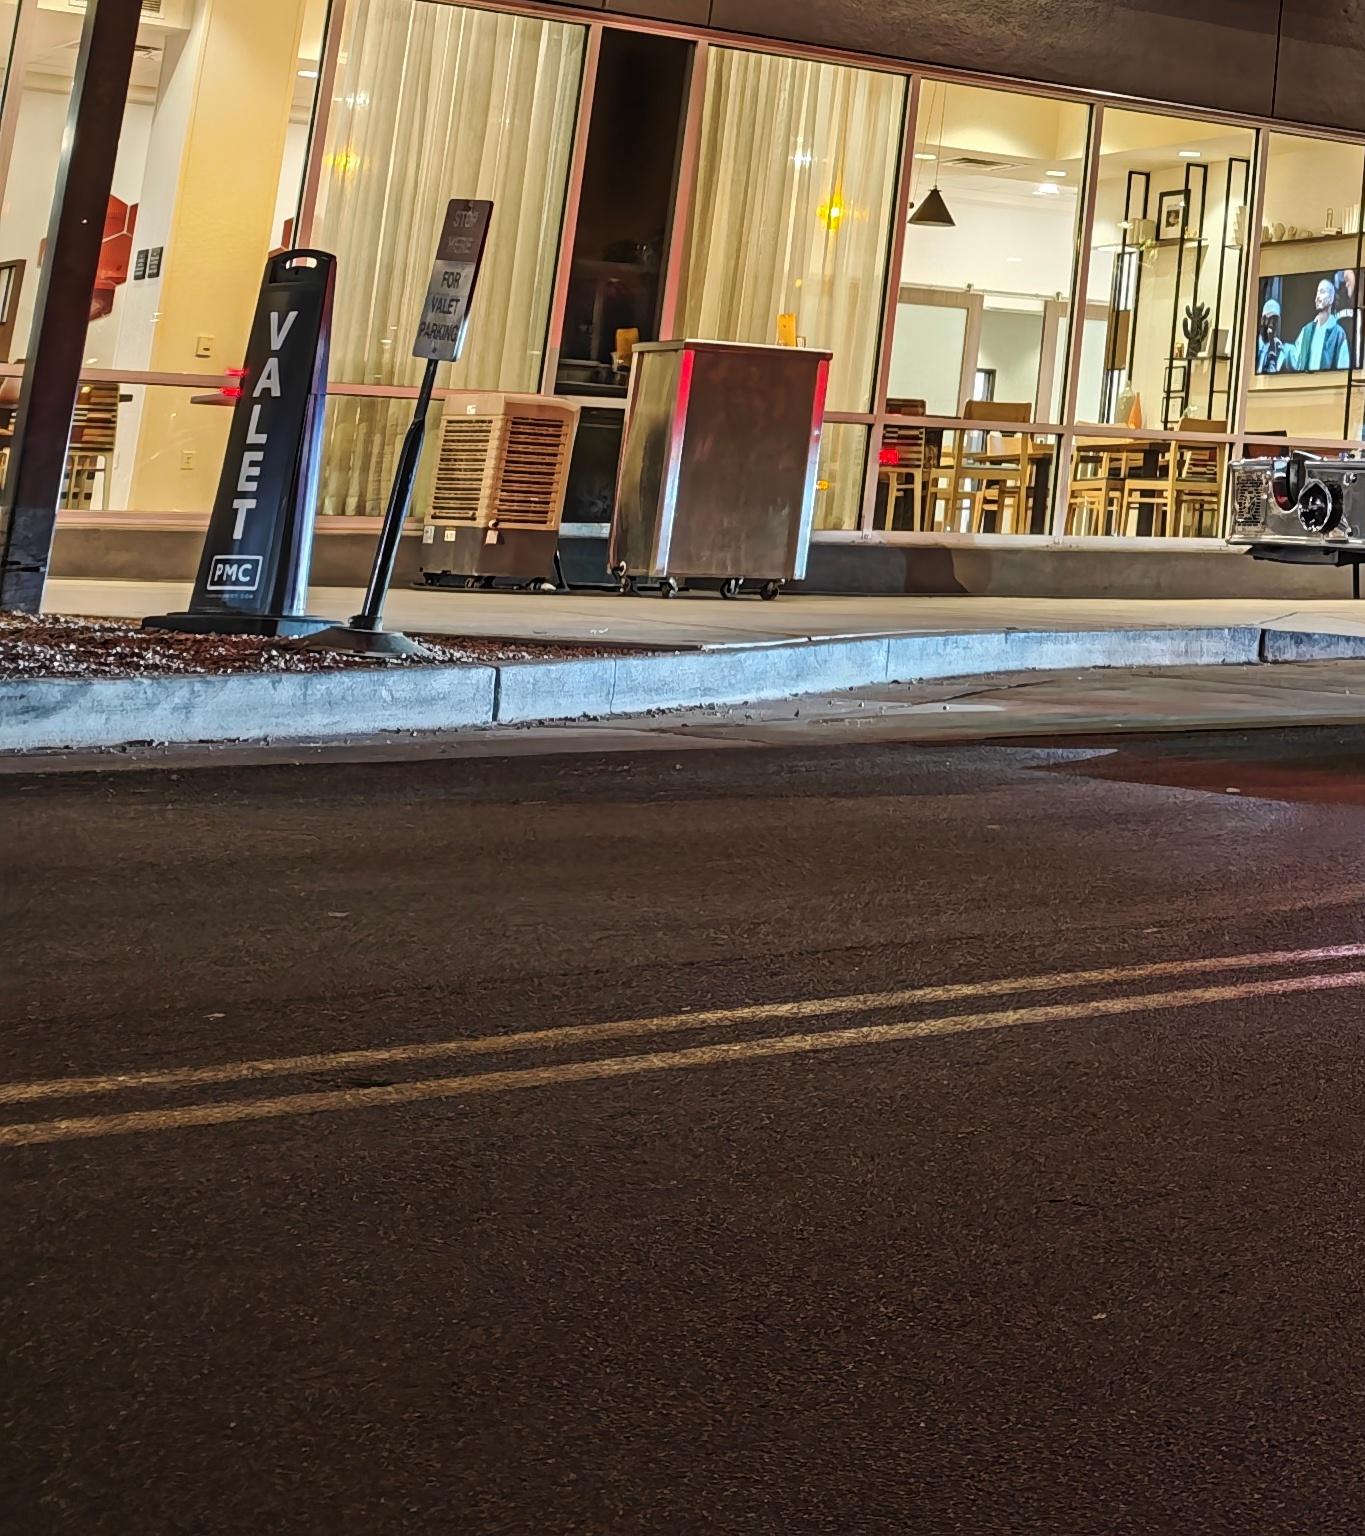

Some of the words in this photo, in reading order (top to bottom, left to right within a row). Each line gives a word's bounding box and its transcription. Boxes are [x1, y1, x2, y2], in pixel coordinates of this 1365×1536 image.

[453, 211, 478, 228] STOP
[440, 271, 462, 289] FOR
[431, 299, 460, 315] VALET
[419, 322, 460, 342] PARKING
[232, 311, 298, 540] VALET
[214, 563, 253, 582] PMC
